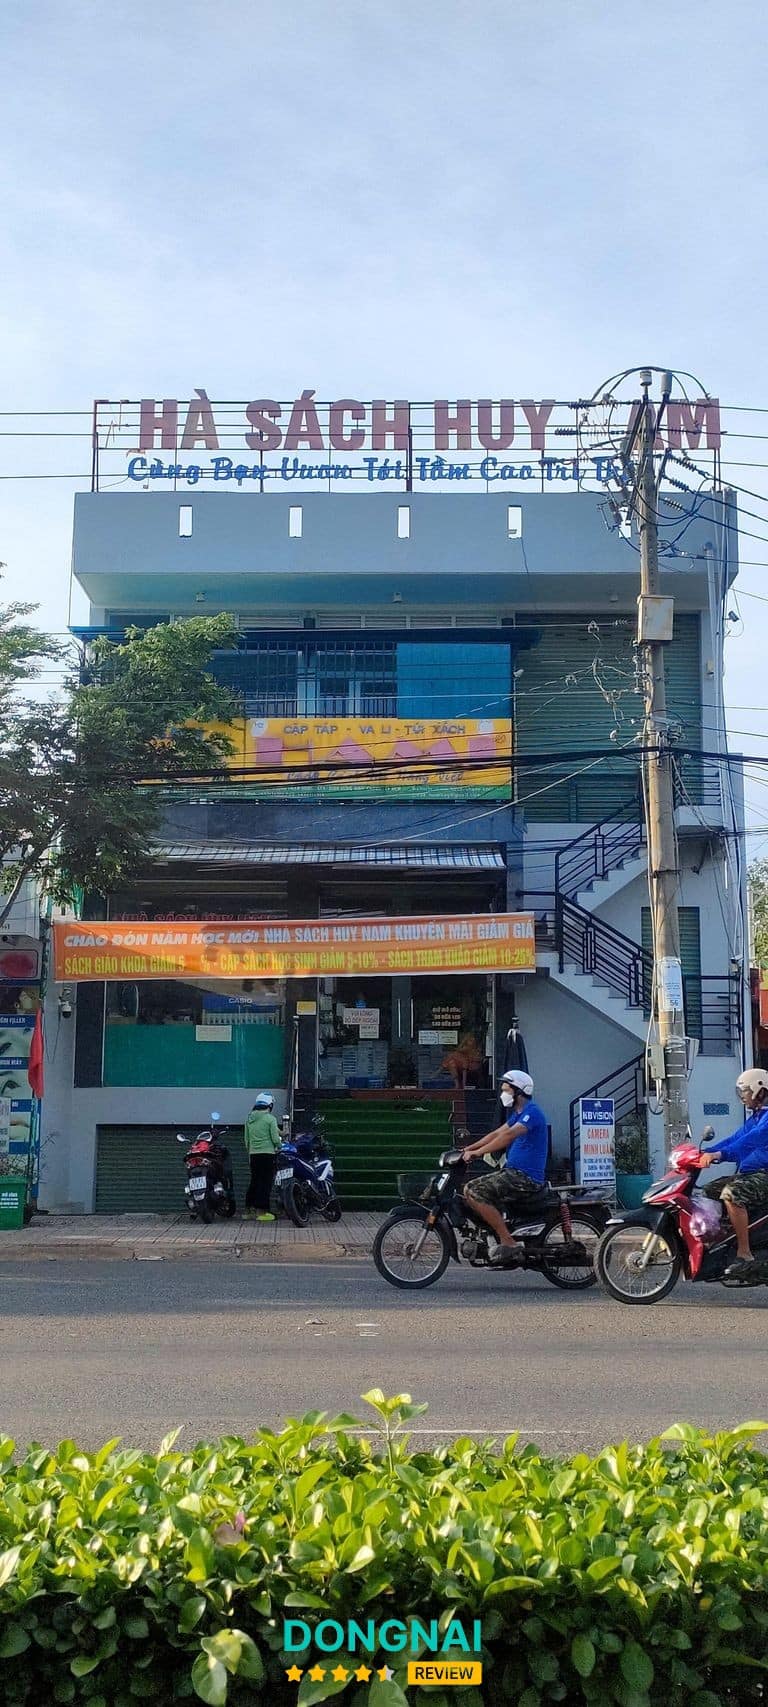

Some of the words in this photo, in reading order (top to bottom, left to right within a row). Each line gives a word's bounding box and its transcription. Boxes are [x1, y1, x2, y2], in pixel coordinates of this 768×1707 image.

[245, 390, 410, 451] SÁCH
[434, 399, 556, 450] HUY
[128, 457, 204, 485] Cùng
[210, 457, 271, 486] Bạn
[480, 457, 536, 480] Cao
[359, 726, 375, 735] VA
[295, 925, 329, 943] SÁCH
[333, 925, 358, 942] HUY
[361, 924, 391, 942] NAM
[65, 954, 92, 976] SÁCH
[95, 954, 118, 975] GIÁO
[121, 955, 148, 974] KHOA
[388, 947, 414, 969] SÁCH
[582, 1111, 614, 1120] KBVISION
[587, 1128, 609, 1139] CAMERA
